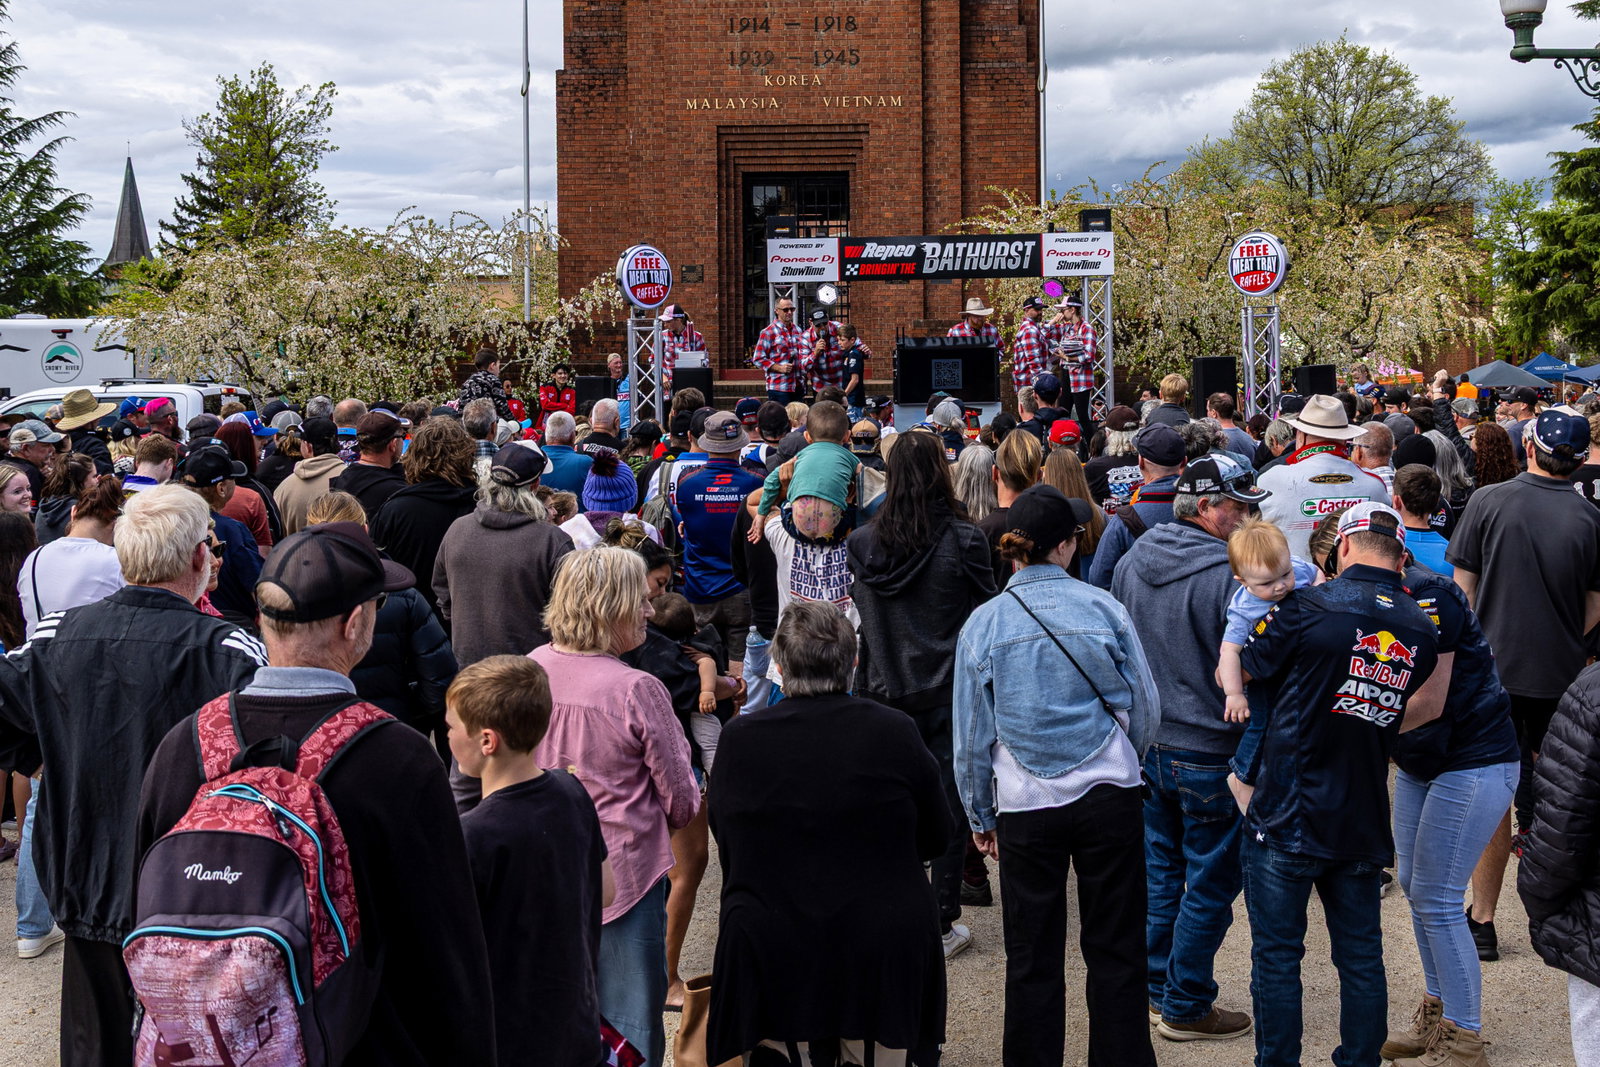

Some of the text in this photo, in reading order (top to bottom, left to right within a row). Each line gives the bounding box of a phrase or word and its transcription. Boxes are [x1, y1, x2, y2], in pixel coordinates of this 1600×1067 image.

[729, 17, 770, 33] 1914
[814, 16, 858, 32] 1918
[729, 50, 775, 67] 1939
[813, 49, 861, 66] 1945
[764, 74, 822, 86] KOREA
[686, 95, 903, 110] MALAYSIA VIETNAM
[861, 242, 916, 260] Repco
[920, 241, 1036, 274] BATHURST
[1046, 249, 1094, 257] Pioneer
[1240, 244, 1269, 257] FREE
[634, 258, 661, 269] FREE
[770, 255, 819, 263] Pioneer
[1056, 260, 1101, 270] ShowTime
[1232, 256, 1277, 277] MEAT TRAY
[780, 266, 825, 276] ShowTime
[859, 263, 916, 275] BRINGIN' THE
[628, 270, 649, 287] MEAT
[650, 270, 668, 286] TRAY
[1240, 271, 1271, 287] RAFFLE'S
[637, 285, 664, 299] RAFFLE'S
[704, 494, 739, 502] PANORAMA
[1318, 499, 1362, 514] Castro
[816, 562, 850, 578] CHOPPE
[820, 573, 852, 589] FRANK
[1349, 655, 1412, 691] Red Bull
[184, 863, 243, 885] Mambo
